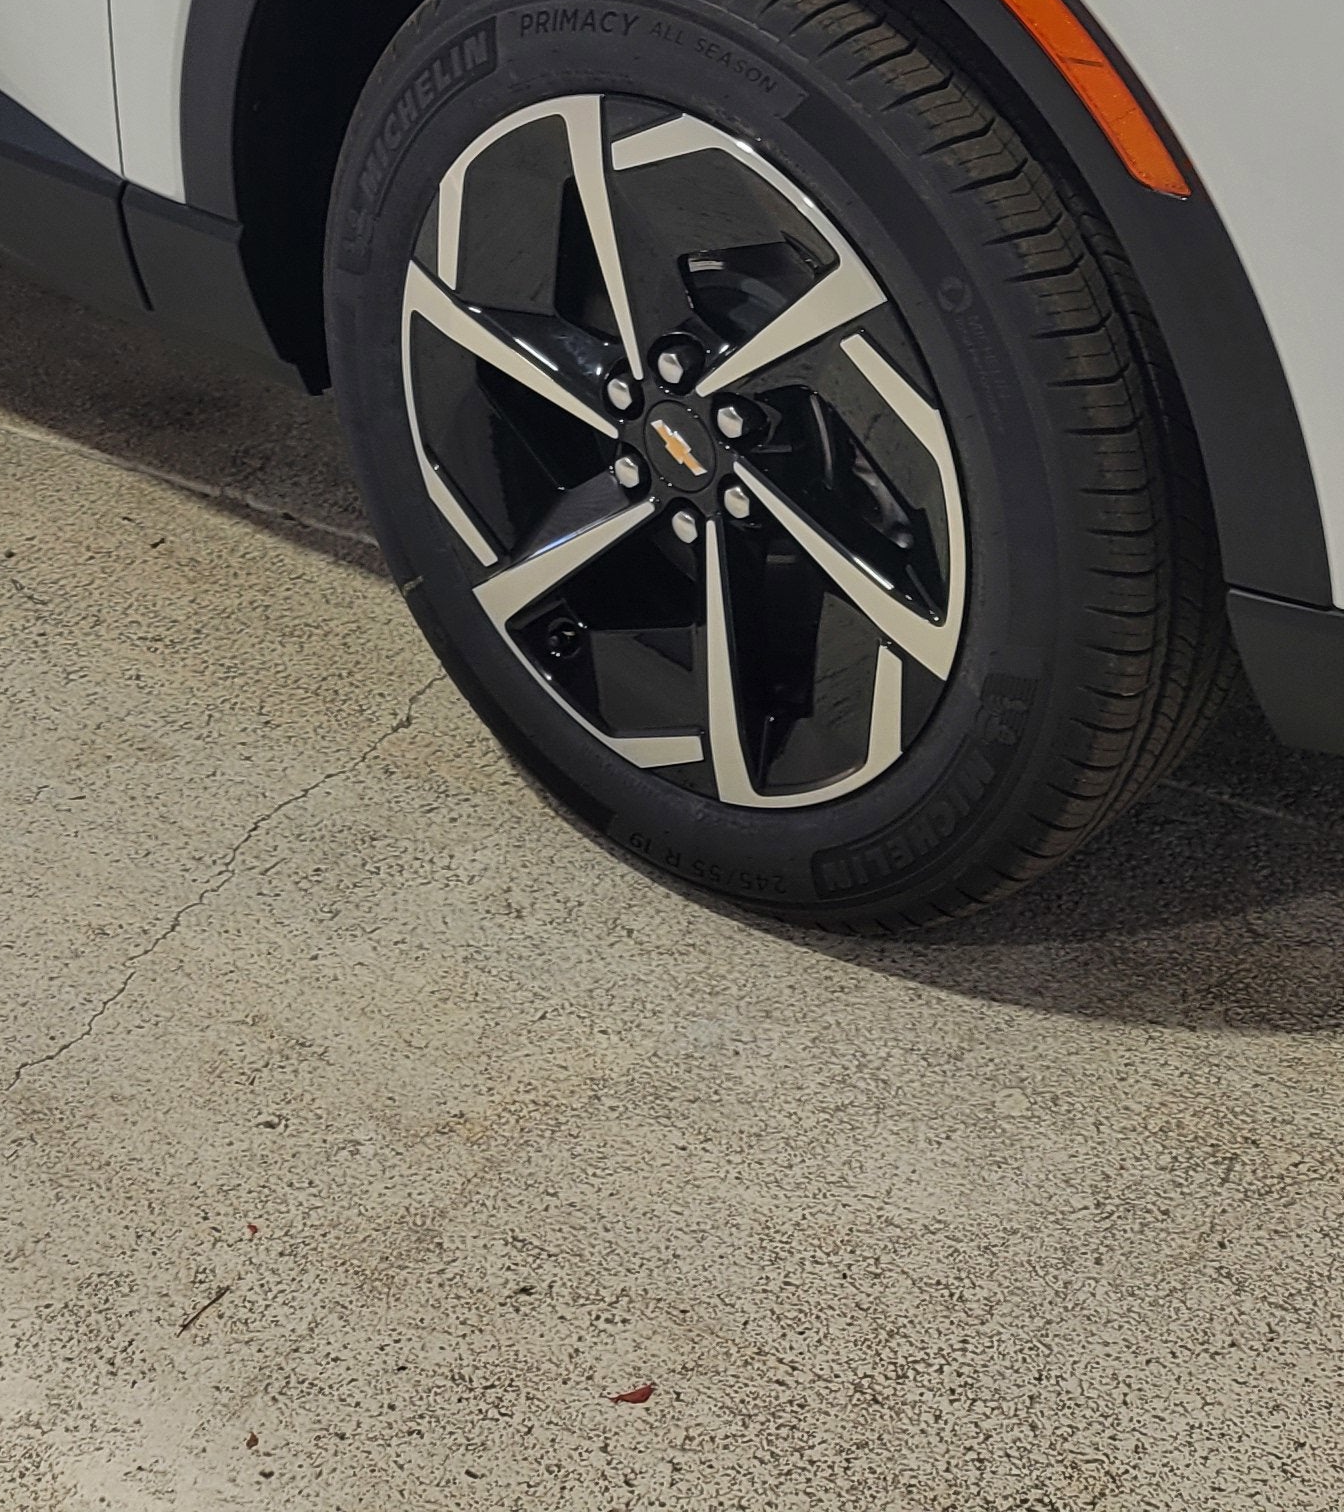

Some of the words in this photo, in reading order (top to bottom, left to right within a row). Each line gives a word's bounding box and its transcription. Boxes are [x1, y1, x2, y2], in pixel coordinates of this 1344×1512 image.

[519, 8, 640, 37] PRIMACY
[649, 22, 684, 46] ALL
[694, 38, 779, 95] SEASON
[358, 30, 490, 200] MICHELIN
[629, 833, 651, 853] 19
[822, 747, 995, 891] MICHELIN
[665, 848, 681, 868] R
[692, 860, 787, 894] 245/55
